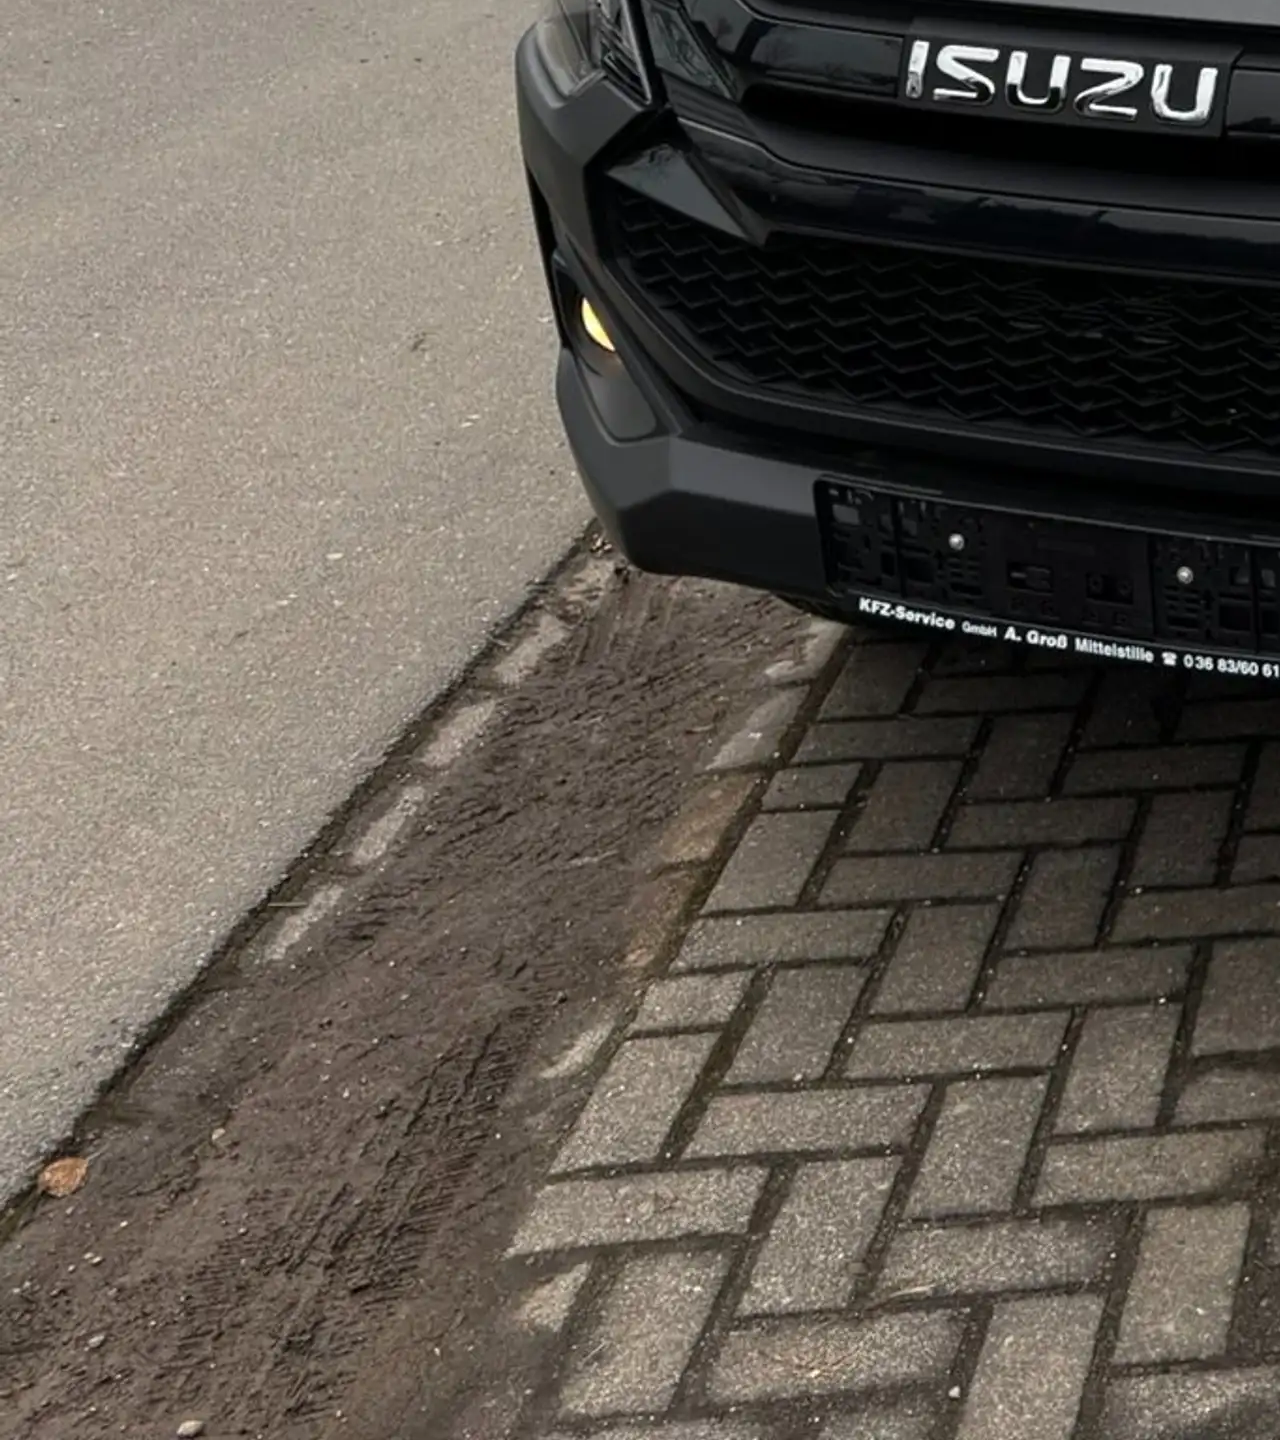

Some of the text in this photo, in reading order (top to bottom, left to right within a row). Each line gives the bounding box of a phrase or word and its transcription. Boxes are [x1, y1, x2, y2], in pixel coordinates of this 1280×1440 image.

[905, 39, 1219, 123] ISUZU
[859, 597, 956, 631] KFZ-Service
[961, 620, 998, 637] GmbH
[1003, 626, 1023, 642] A.
[1026, 630, 1068, 650] Groß
[1075, 637, 1154, 663] Mittelstille
[1217, 657, 1259, 677] 83/60
[1262, 663, 1280, 678] 61
